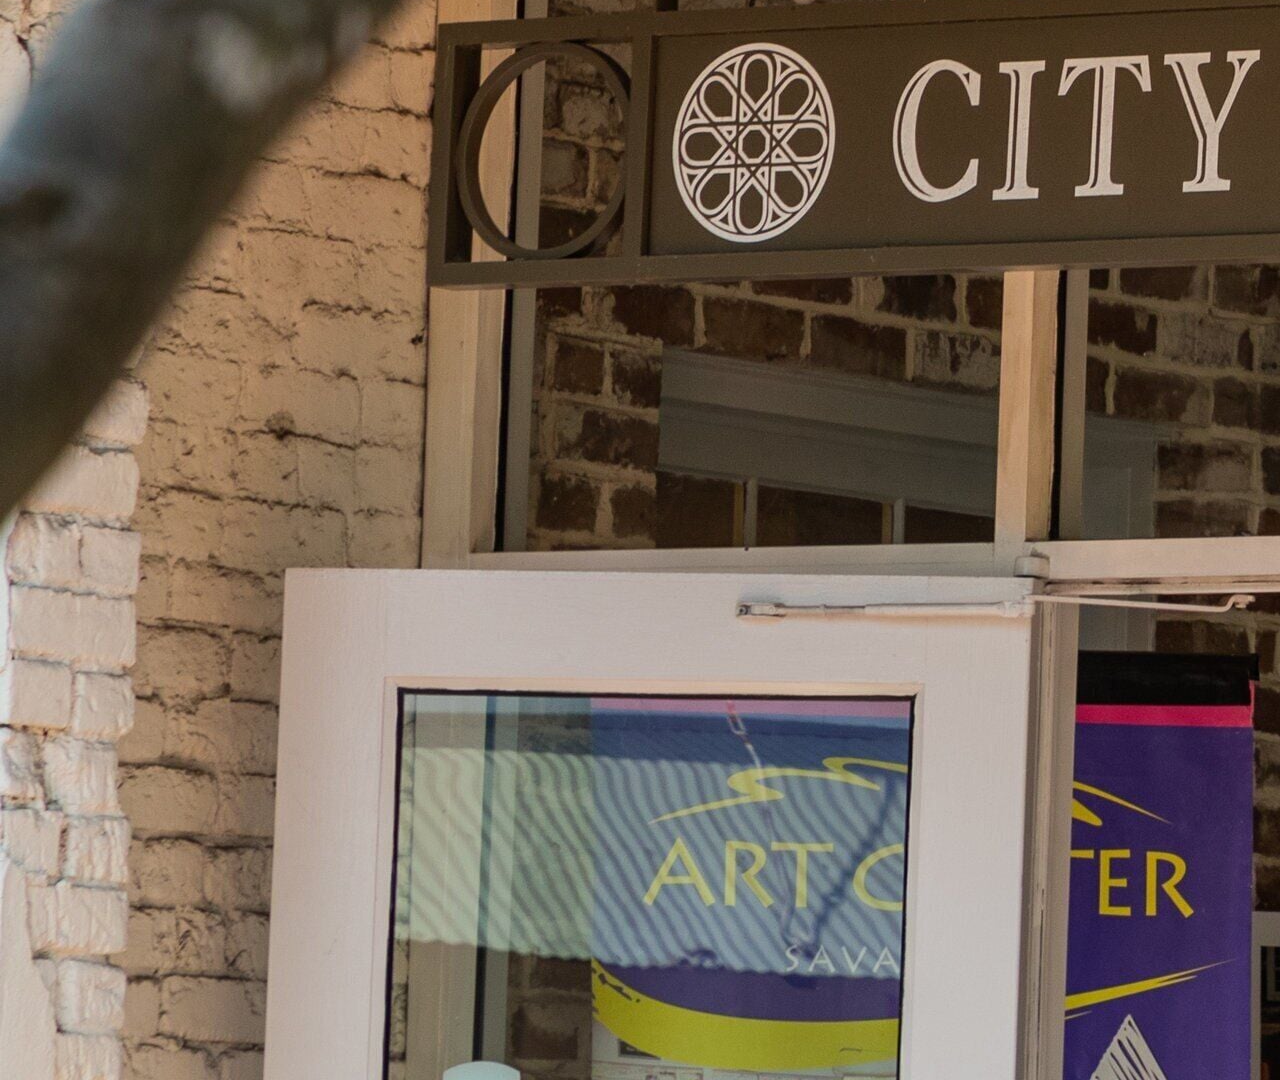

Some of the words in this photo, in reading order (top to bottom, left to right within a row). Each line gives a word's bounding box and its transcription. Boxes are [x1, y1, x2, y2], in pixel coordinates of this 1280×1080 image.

[893, 49, 1261, 204] CITY
[642, 837, 834, 909] ART
[785, 943, 900, 974] SAVA
